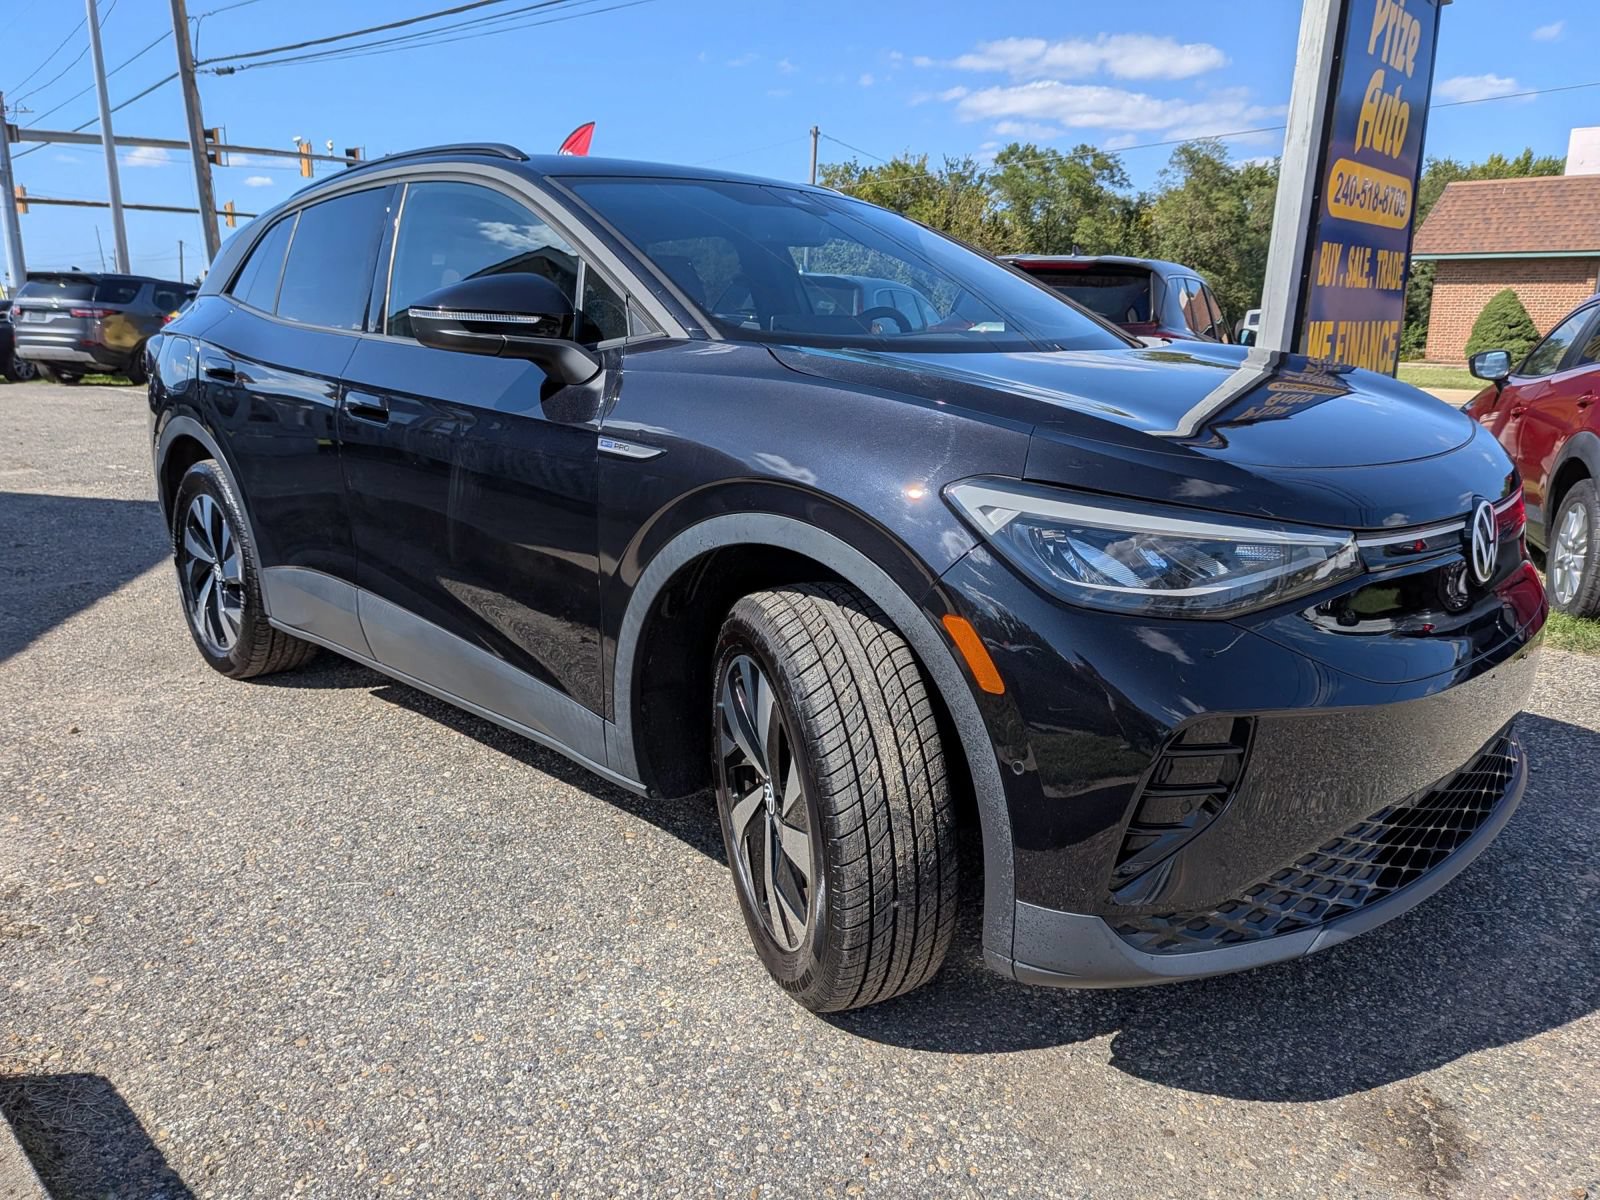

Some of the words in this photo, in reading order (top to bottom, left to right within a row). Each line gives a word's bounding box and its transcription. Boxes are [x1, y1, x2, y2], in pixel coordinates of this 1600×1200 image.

[1368, 0, 1421, 78] Prize
[1355, 70, 1410, 159] Auto
[1376, 250, 1405, 290] TRADE
[1335, 321, 1398, 373] FINANCE
